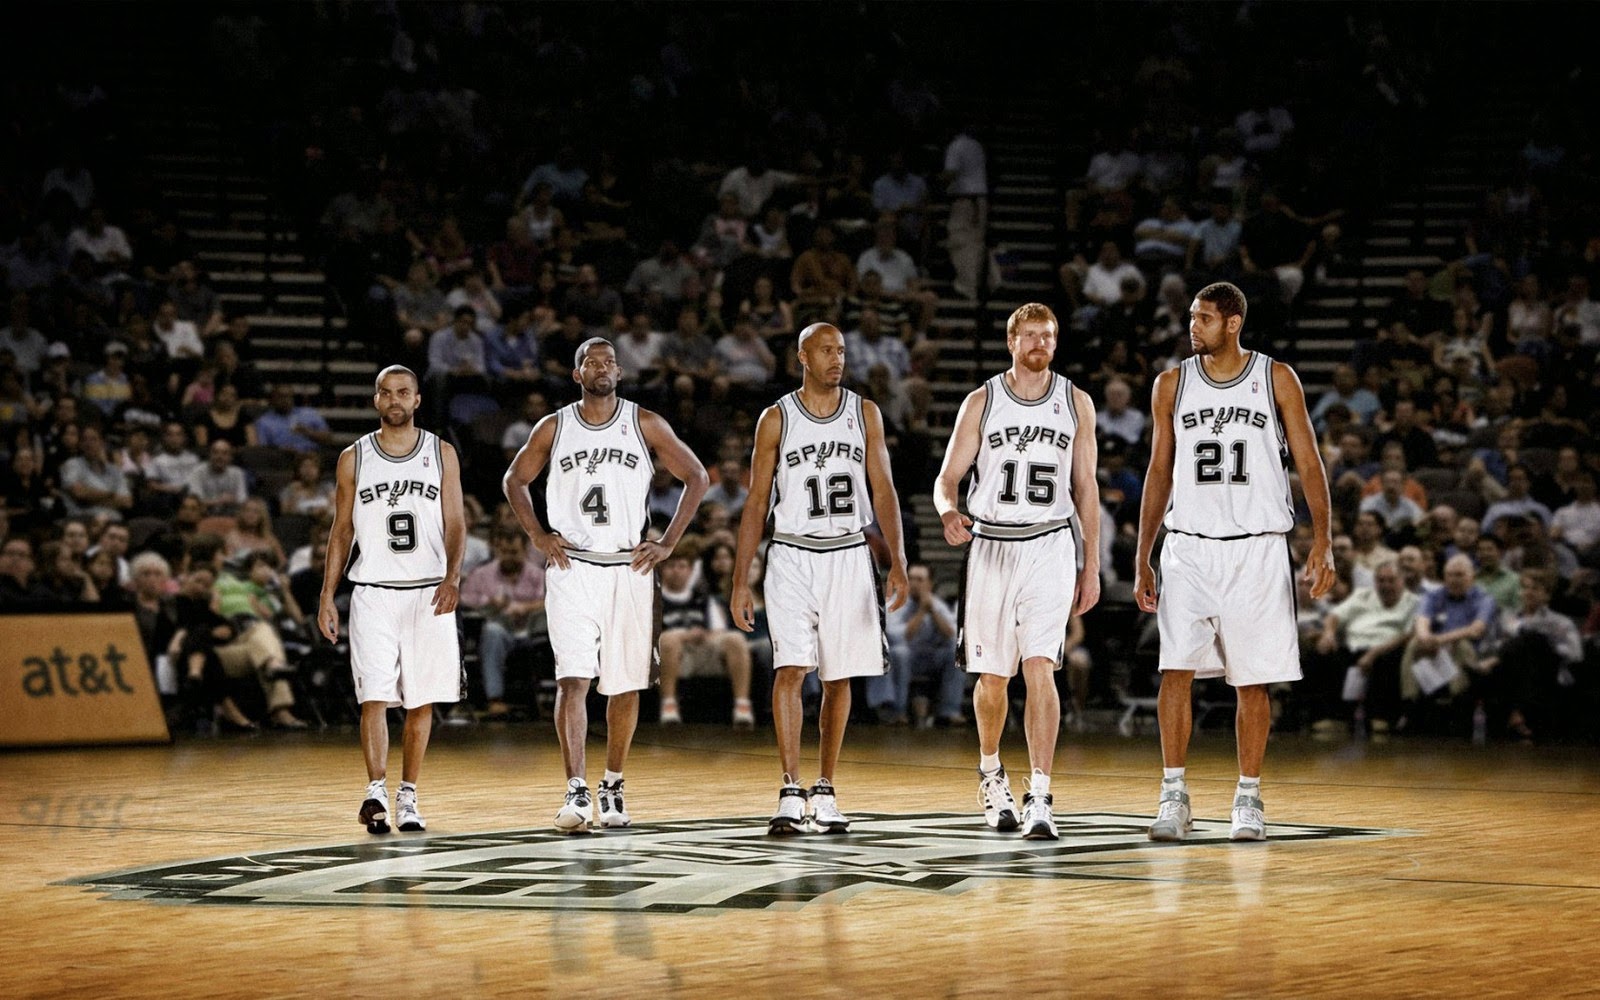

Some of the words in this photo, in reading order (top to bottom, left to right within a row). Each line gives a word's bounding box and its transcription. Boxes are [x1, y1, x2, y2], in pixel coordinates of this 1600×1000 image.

[988, 425, 1071, 454] SPURS
[1181, 406, 1268, 436] SPURS
[559, 447, 640, 475] SPURS
[785, 440, 865, 471] SPURS
[1193, 440, 1250, 486] 21
[359, 480, 440, 508] SPURS
[804, 472, 856, 520] 12
[997, 460, 1059, 507] 15
[580, 484, 610, 526] 4
[386, 510, 418, 553] 9
[22, 643, 134, 698] at&t
